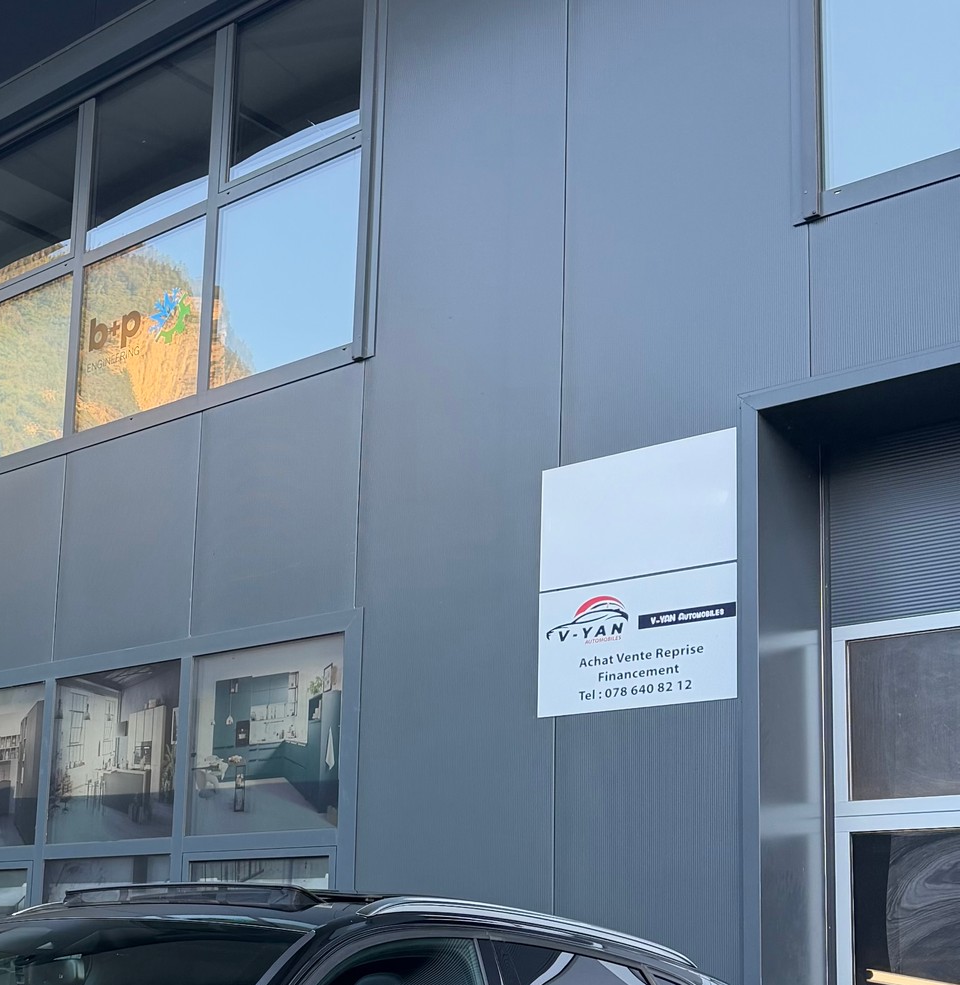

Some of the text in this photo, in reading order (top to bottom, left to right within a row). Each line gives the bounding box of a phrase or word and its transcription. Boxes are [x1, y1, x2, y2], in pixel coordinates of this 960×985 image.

[86, 346, 140, 373] ENGINEERING
[585, 635, 621, 645] AUTOMOBILES
[579, 644, 704, 668] Achat Vente Reprise
[598, 664, 680, 682] Financement
[604, 687, 628, 698] 078
[630, 683, 654, 695] 640
[657, 681, 673, 693] 82
[677, 679, 692, 691] 12
